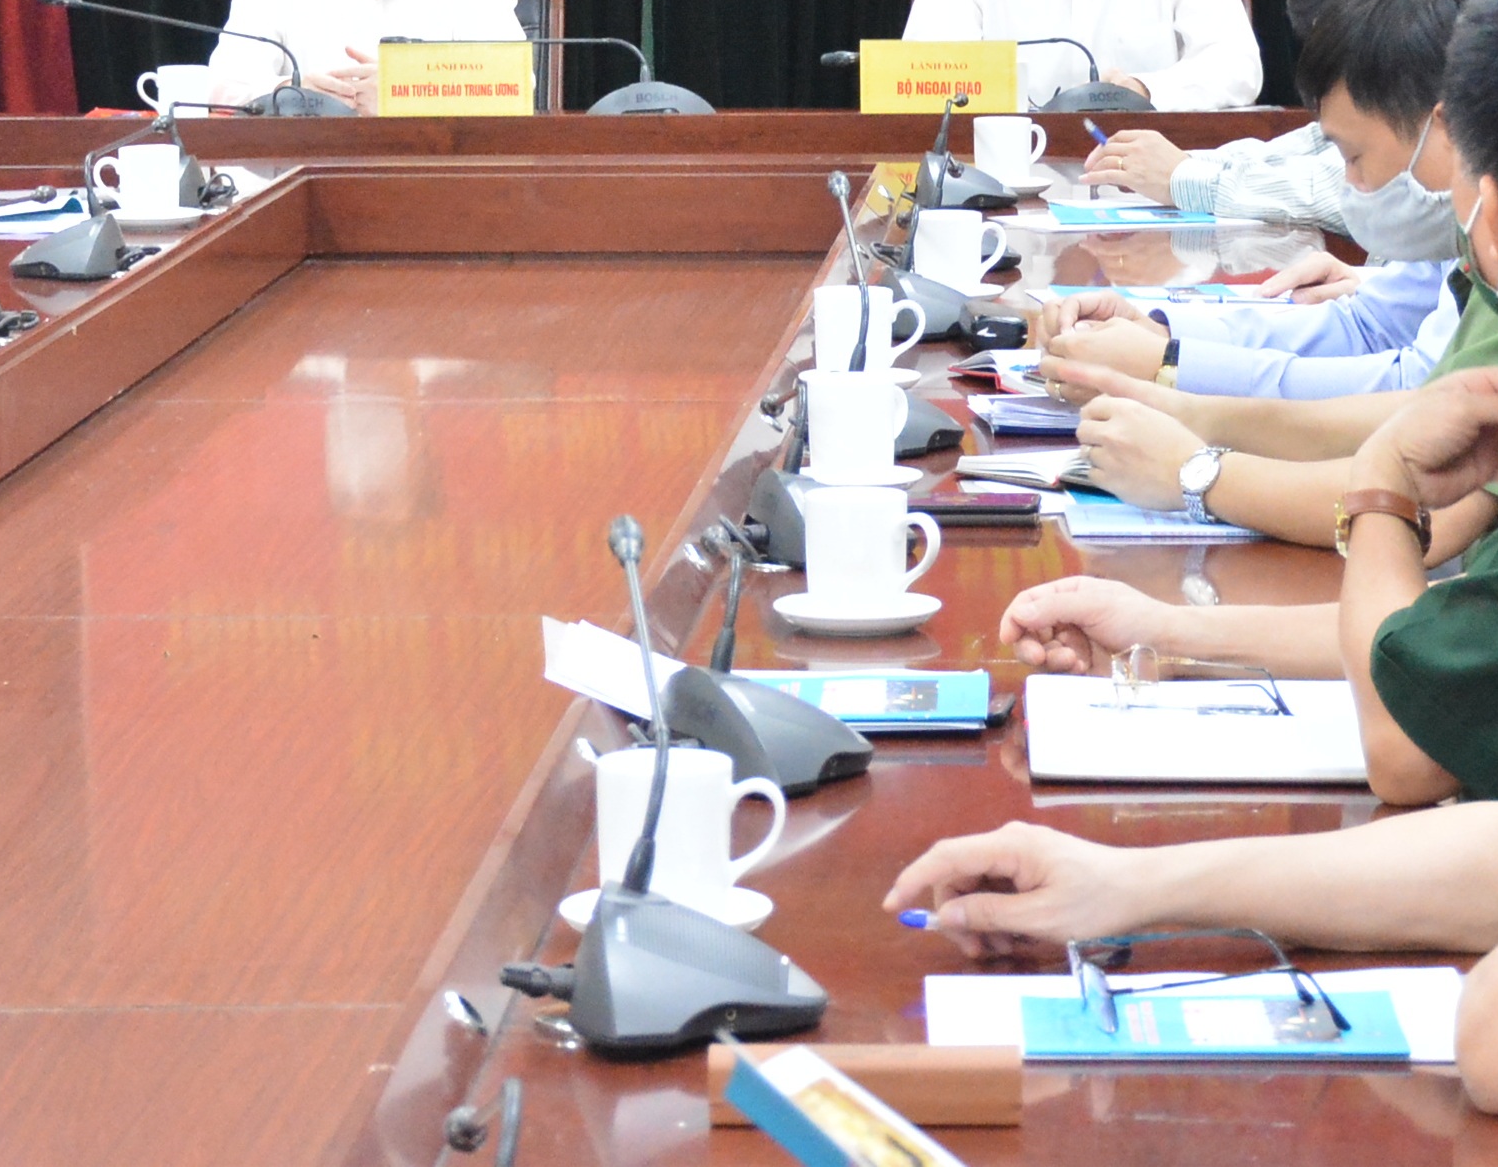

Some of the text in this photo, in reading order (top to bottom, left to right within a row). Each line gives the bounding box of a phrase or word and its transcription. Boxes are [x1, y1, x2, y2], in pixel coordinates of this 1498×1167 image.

[392, 85, 409, 97] BAN
[412, 82, 439, 97] TUYÊN
[464, 84, 493, 97] TRUNG
[897, 78, 982, 99] BỘ NGOẠI GIAO
